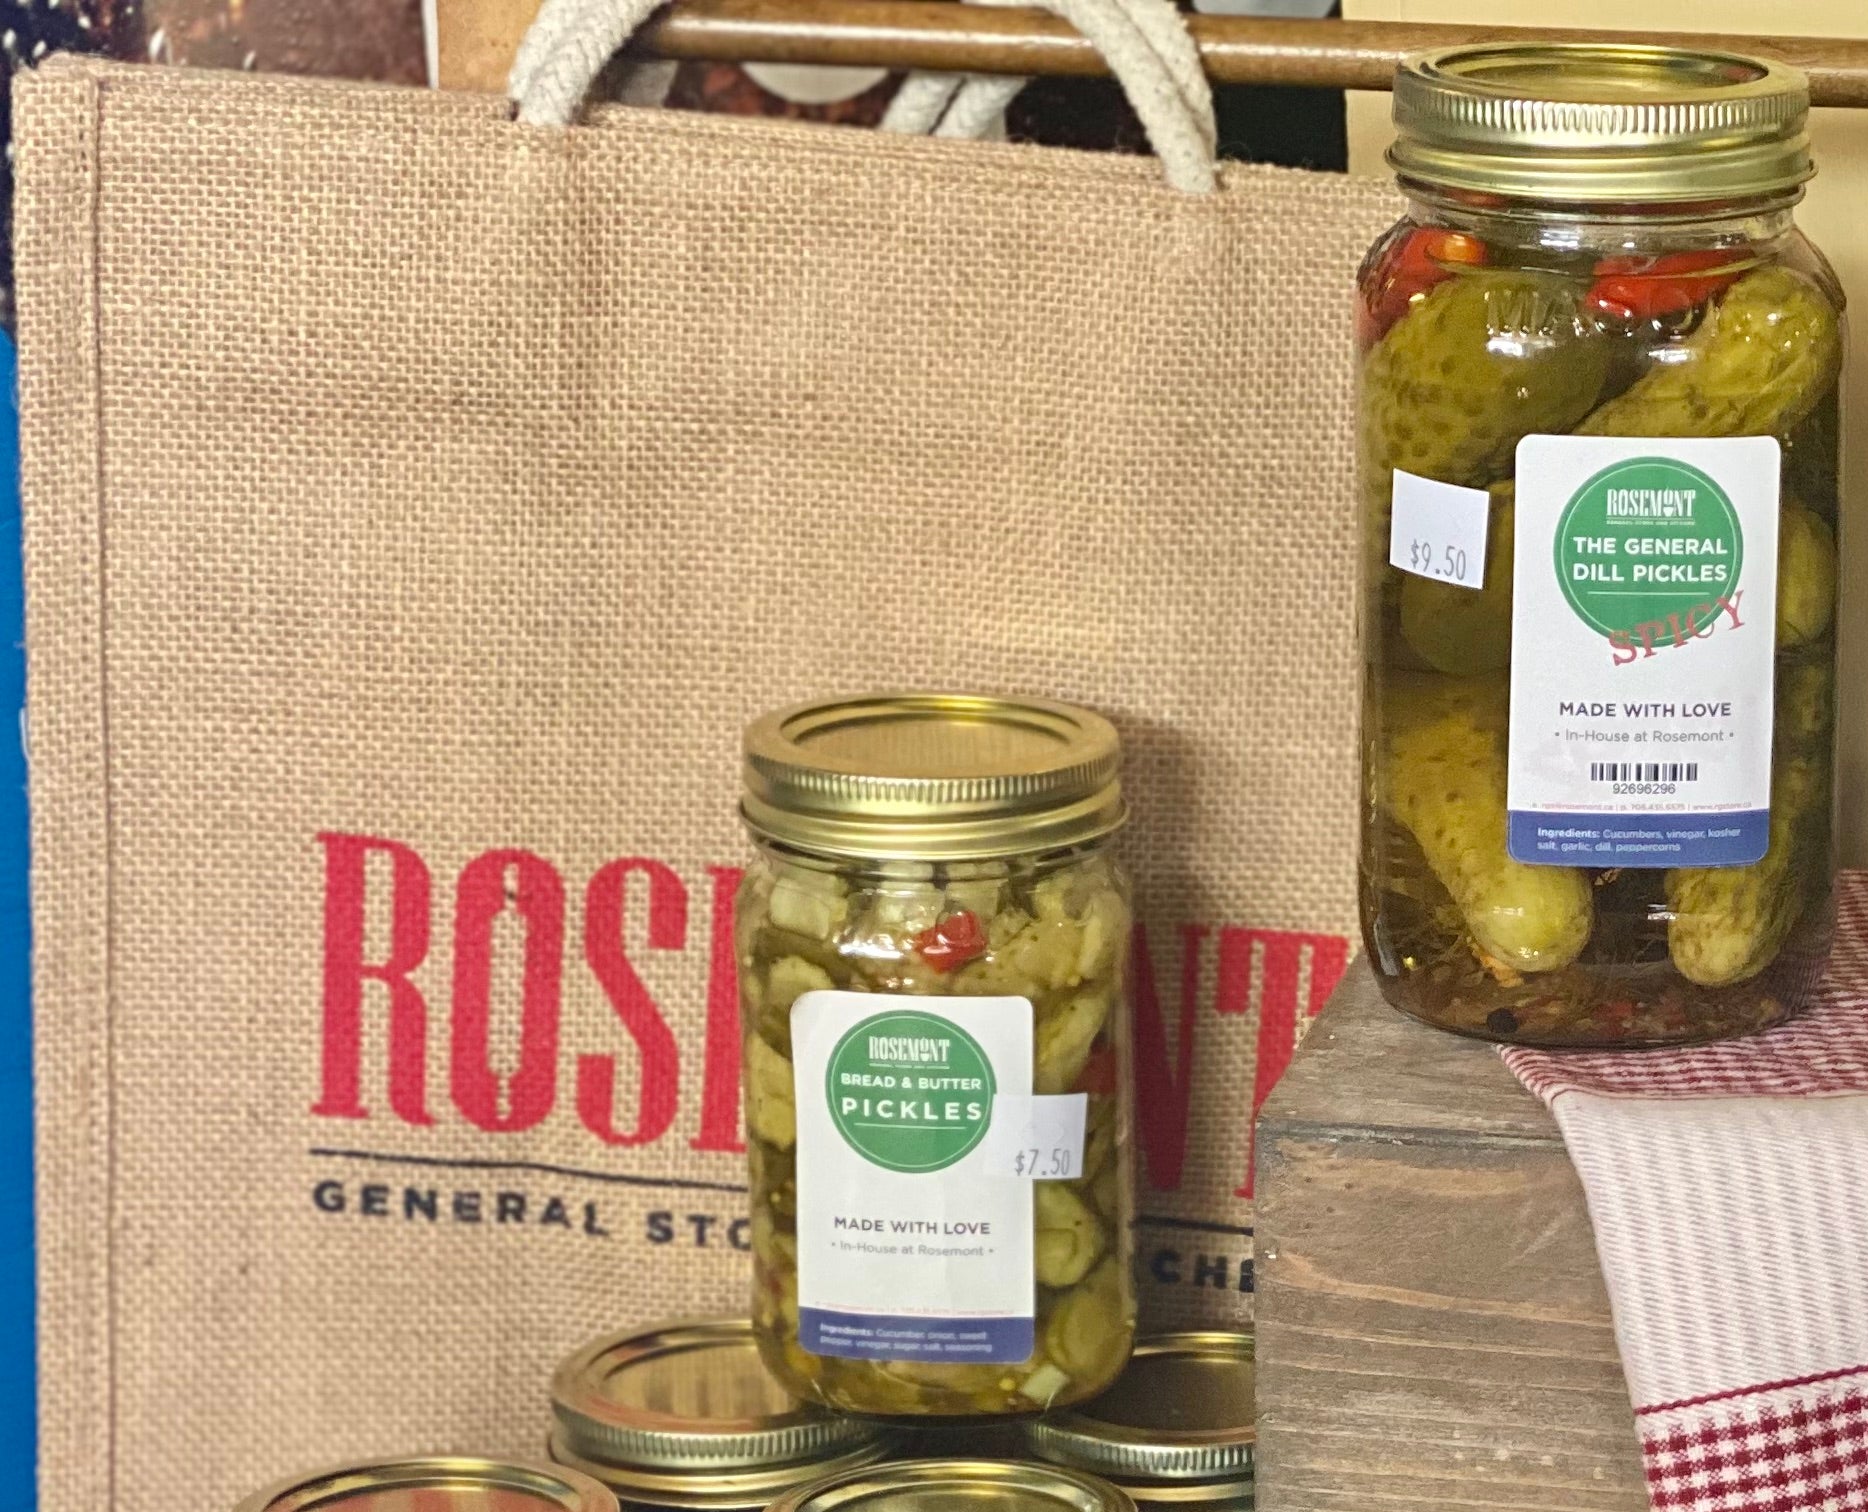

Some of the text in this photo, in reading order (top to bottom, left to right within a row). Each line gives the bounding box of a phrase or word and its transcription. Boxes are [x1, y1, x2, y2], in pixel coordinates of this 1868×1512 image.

[1606, 489, 1696, 517] ROSEMONT
[1573, 537, 1728, 555] THE GENERAL
[1410, 539, 1466, 581] $9.50
[1573, 564, 1727, 582] DILL PICKLES
[1608, 590, 1745, 666] SPICY
[1559, 702, 1731, 718] MADE WITH LOVE
[1565, 729, 1724, 742] In-House at Rosemont
[1613, 784, 1675, 794] 92696296
[869, 1036, 950, 1062] ROSEMONT
[841, 1073, 981, 1090] BREAD & BUTTER
[842, 1098, 981, 1121] PICKLES
[1015, 1148, 1070, 1177] $7.50
[313, 1180, 751, 1251] GENERAL STO
[834, 1217, 990, 1235] MADE WITH LOVE
[840, 1241, 984, 1257] In-House at Rosemont
